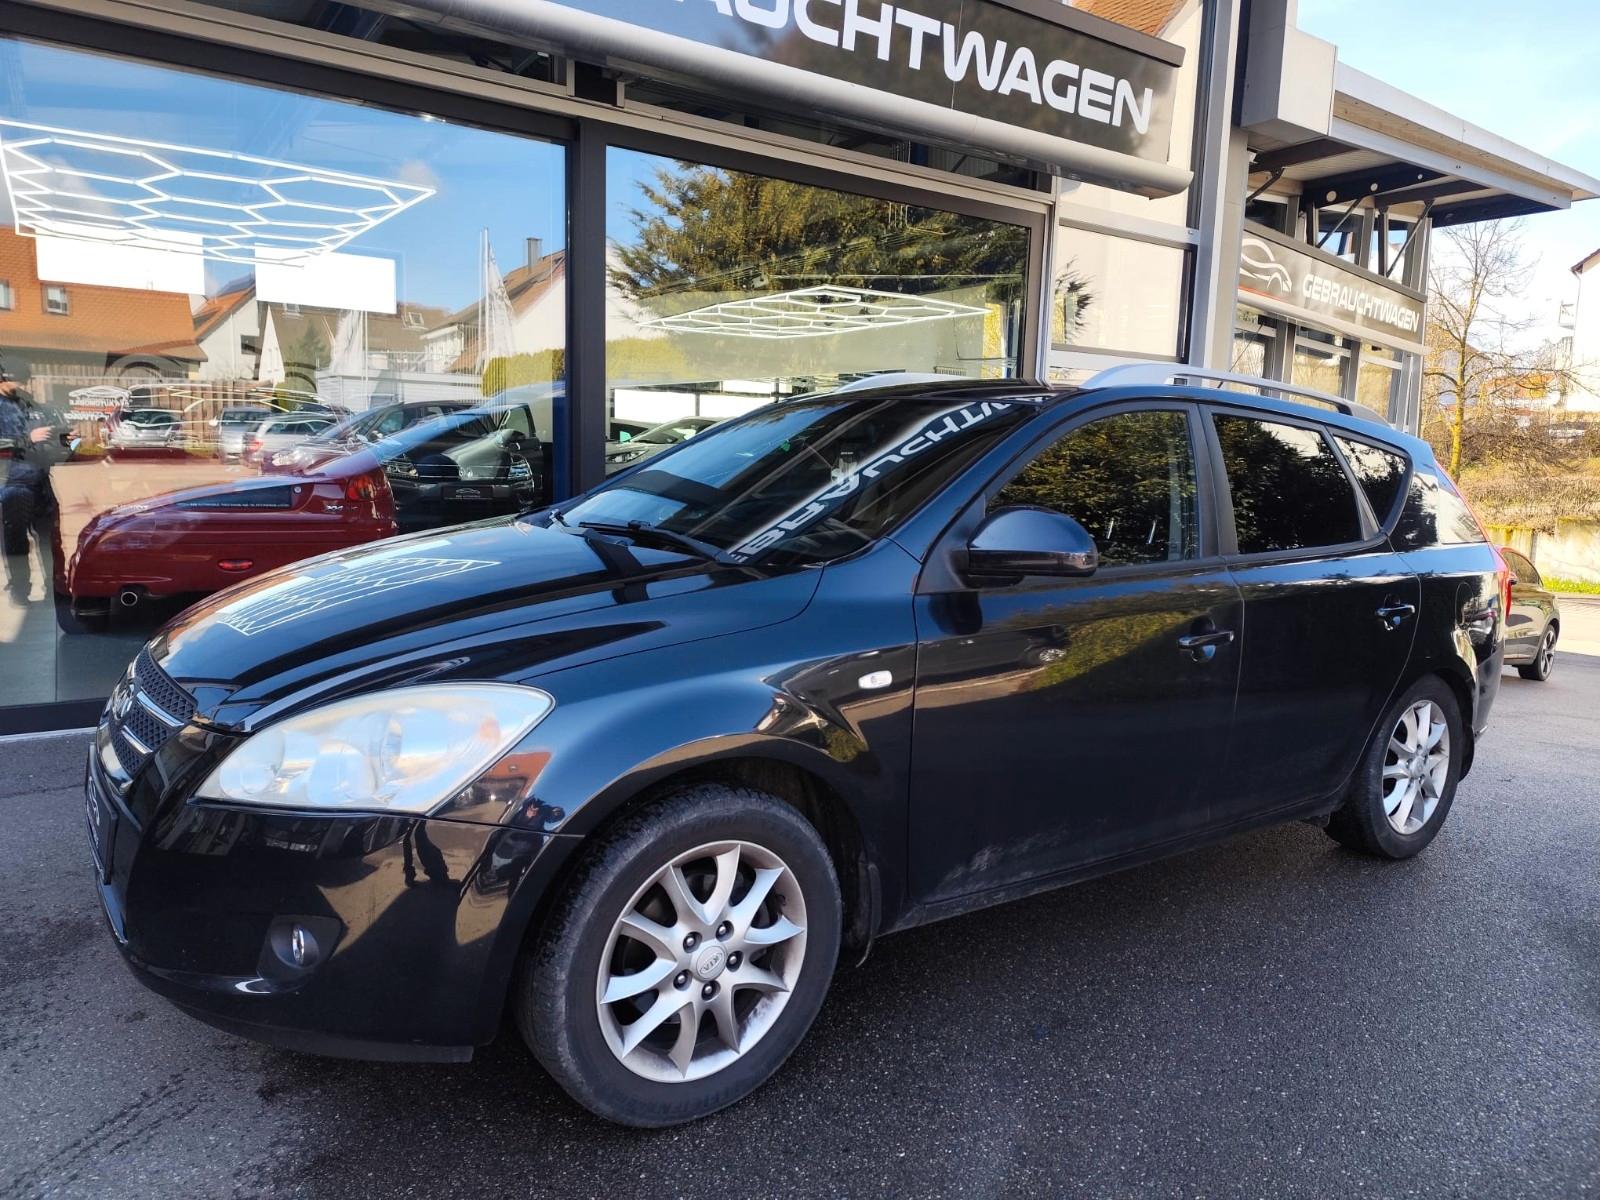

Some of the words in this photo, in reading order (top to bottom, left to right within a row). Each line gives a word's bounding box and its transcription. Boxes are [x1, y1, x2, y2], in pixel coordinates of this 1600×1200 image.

[674, 0, 1153, 135] CHTWAGEN
[1302, 273, 1421, 333] GEBRAUCHTWAGEN
[702, 955, 721, 972] KIA
